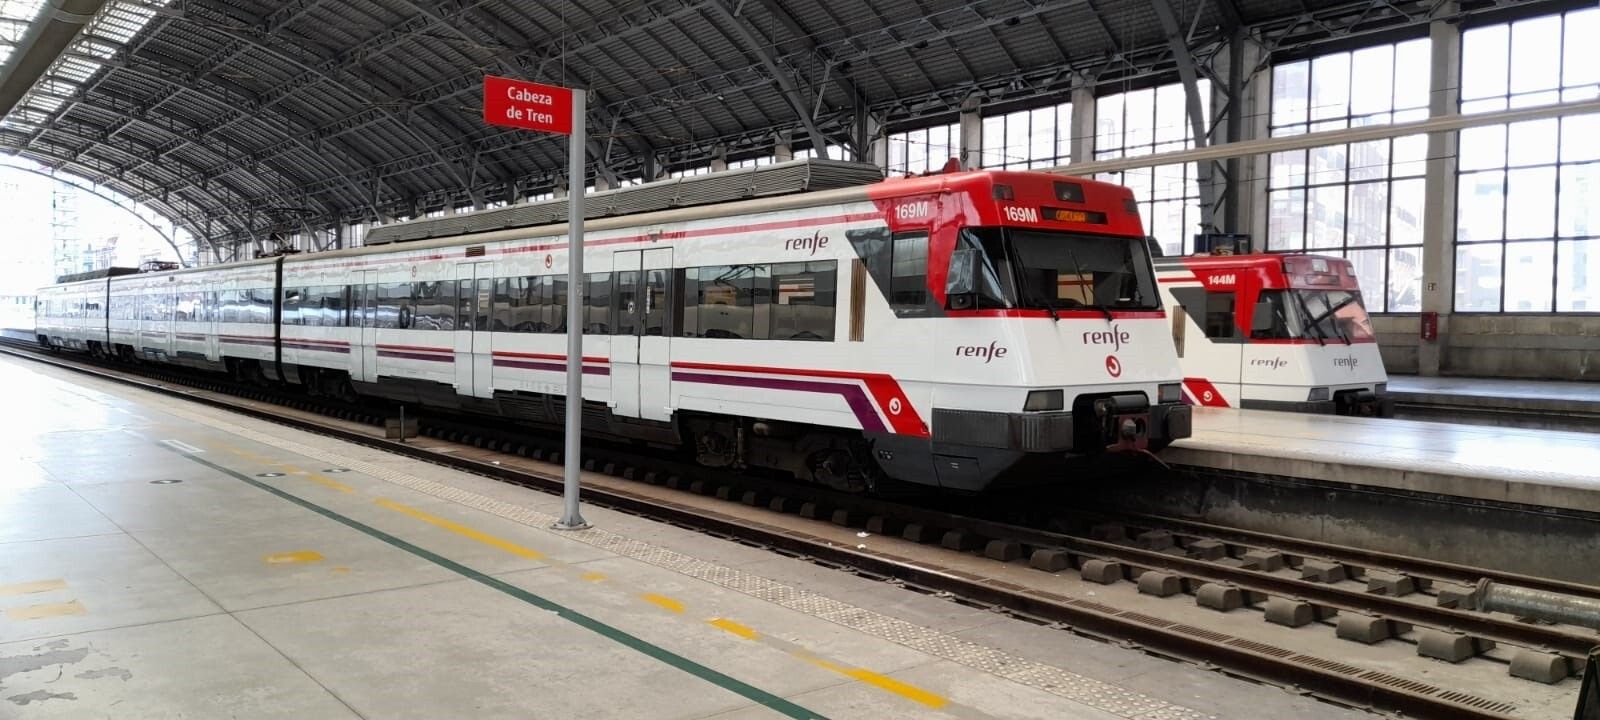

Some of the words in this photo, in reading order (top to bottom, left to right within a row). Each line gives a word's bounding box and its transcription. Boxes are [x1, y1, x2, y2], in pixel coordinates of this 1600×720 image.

[507, 86, 552, 106] Cabeza
[506, 105, 522, 120] de
[526, 108, 553, 124] Tren
[895, 201, 928, 220] 169M
[1004, 205, 1038, 223] 169M
[785, 229, 829, 256] renfe
[1208, 274, 1236, 286] 144M
[1083, 324, 1130, 352] renfe
[956, 340, 1007, 364] renfe
[1250, 356, 1288, 370] renfe
[1333, 354, 1358, 372] renfe
